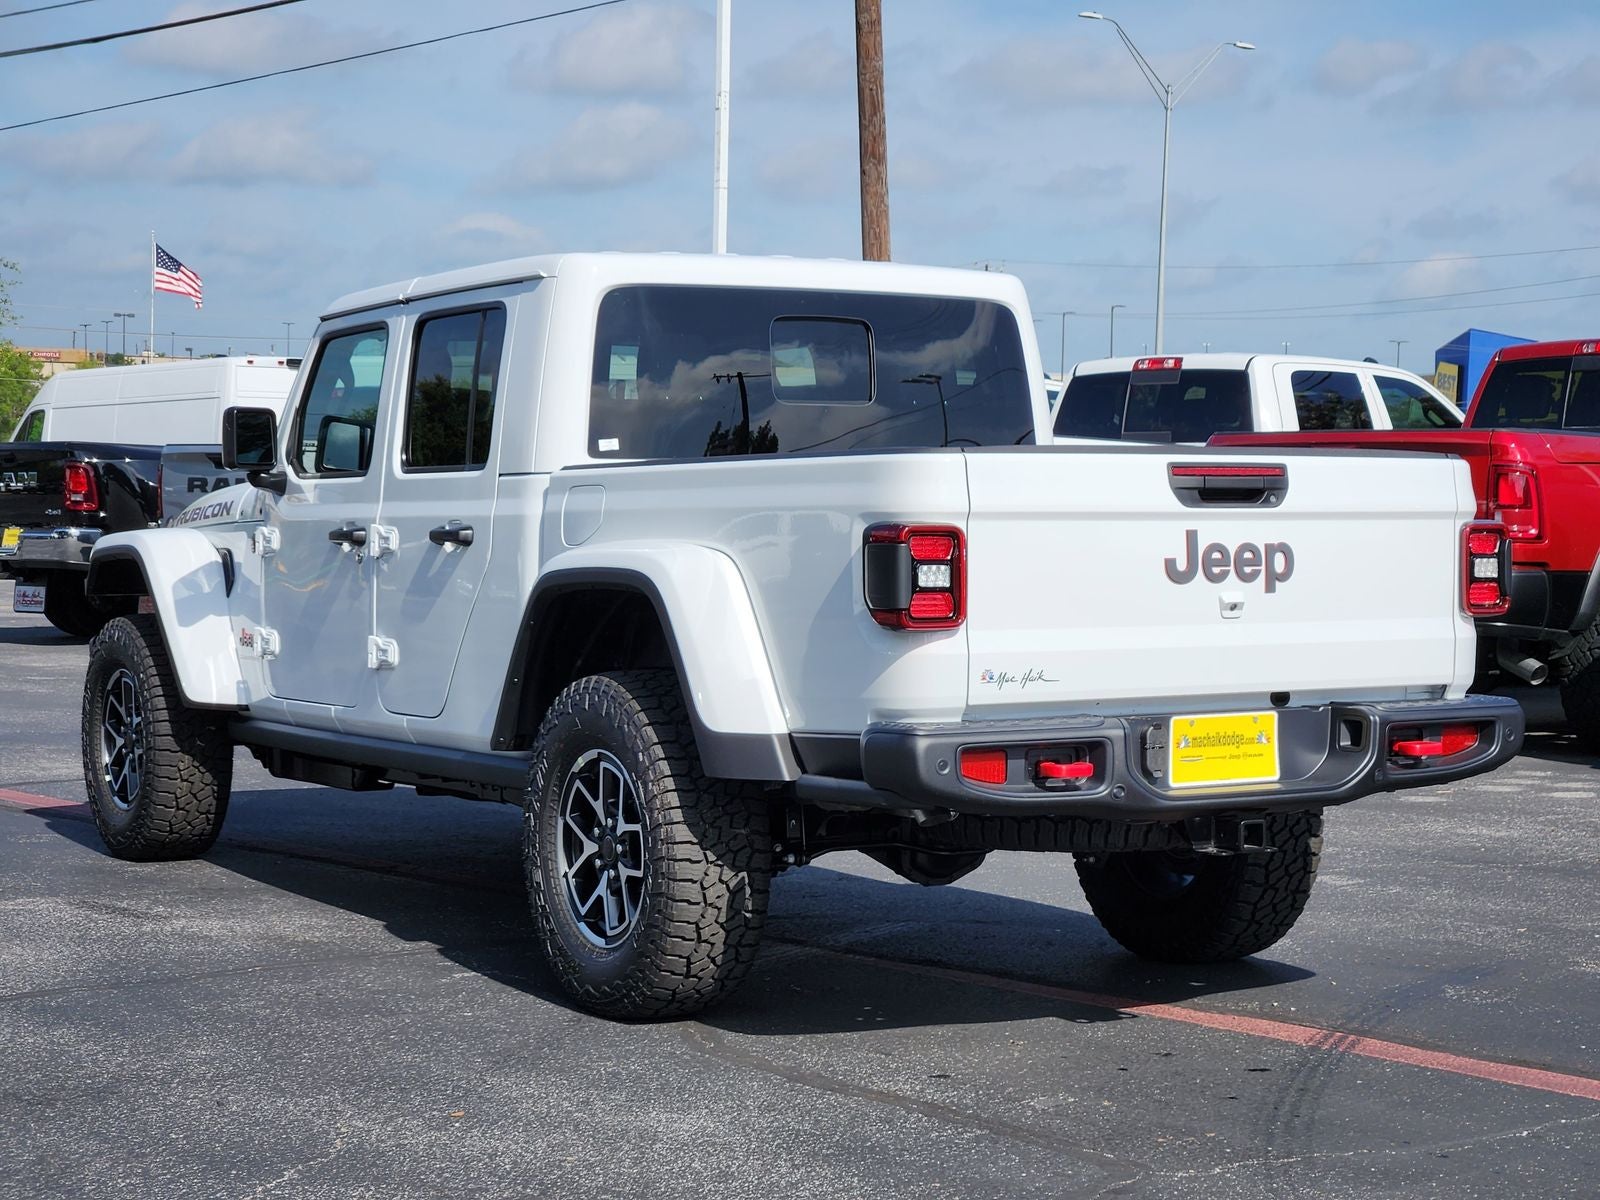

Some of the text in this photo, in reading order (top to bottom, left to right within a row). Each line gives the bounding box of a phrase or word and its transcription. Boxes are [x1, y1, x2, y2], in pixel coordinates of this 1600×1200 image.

[0, 471, 38, 490] AM
[177, 500, 234, 525] RUBICON
[1163, 529, 1295, 593] Jeep
[996, 668, 1060, 690] Mac Haik
[1191, 731, 1256, 749] machaikdodge.com
